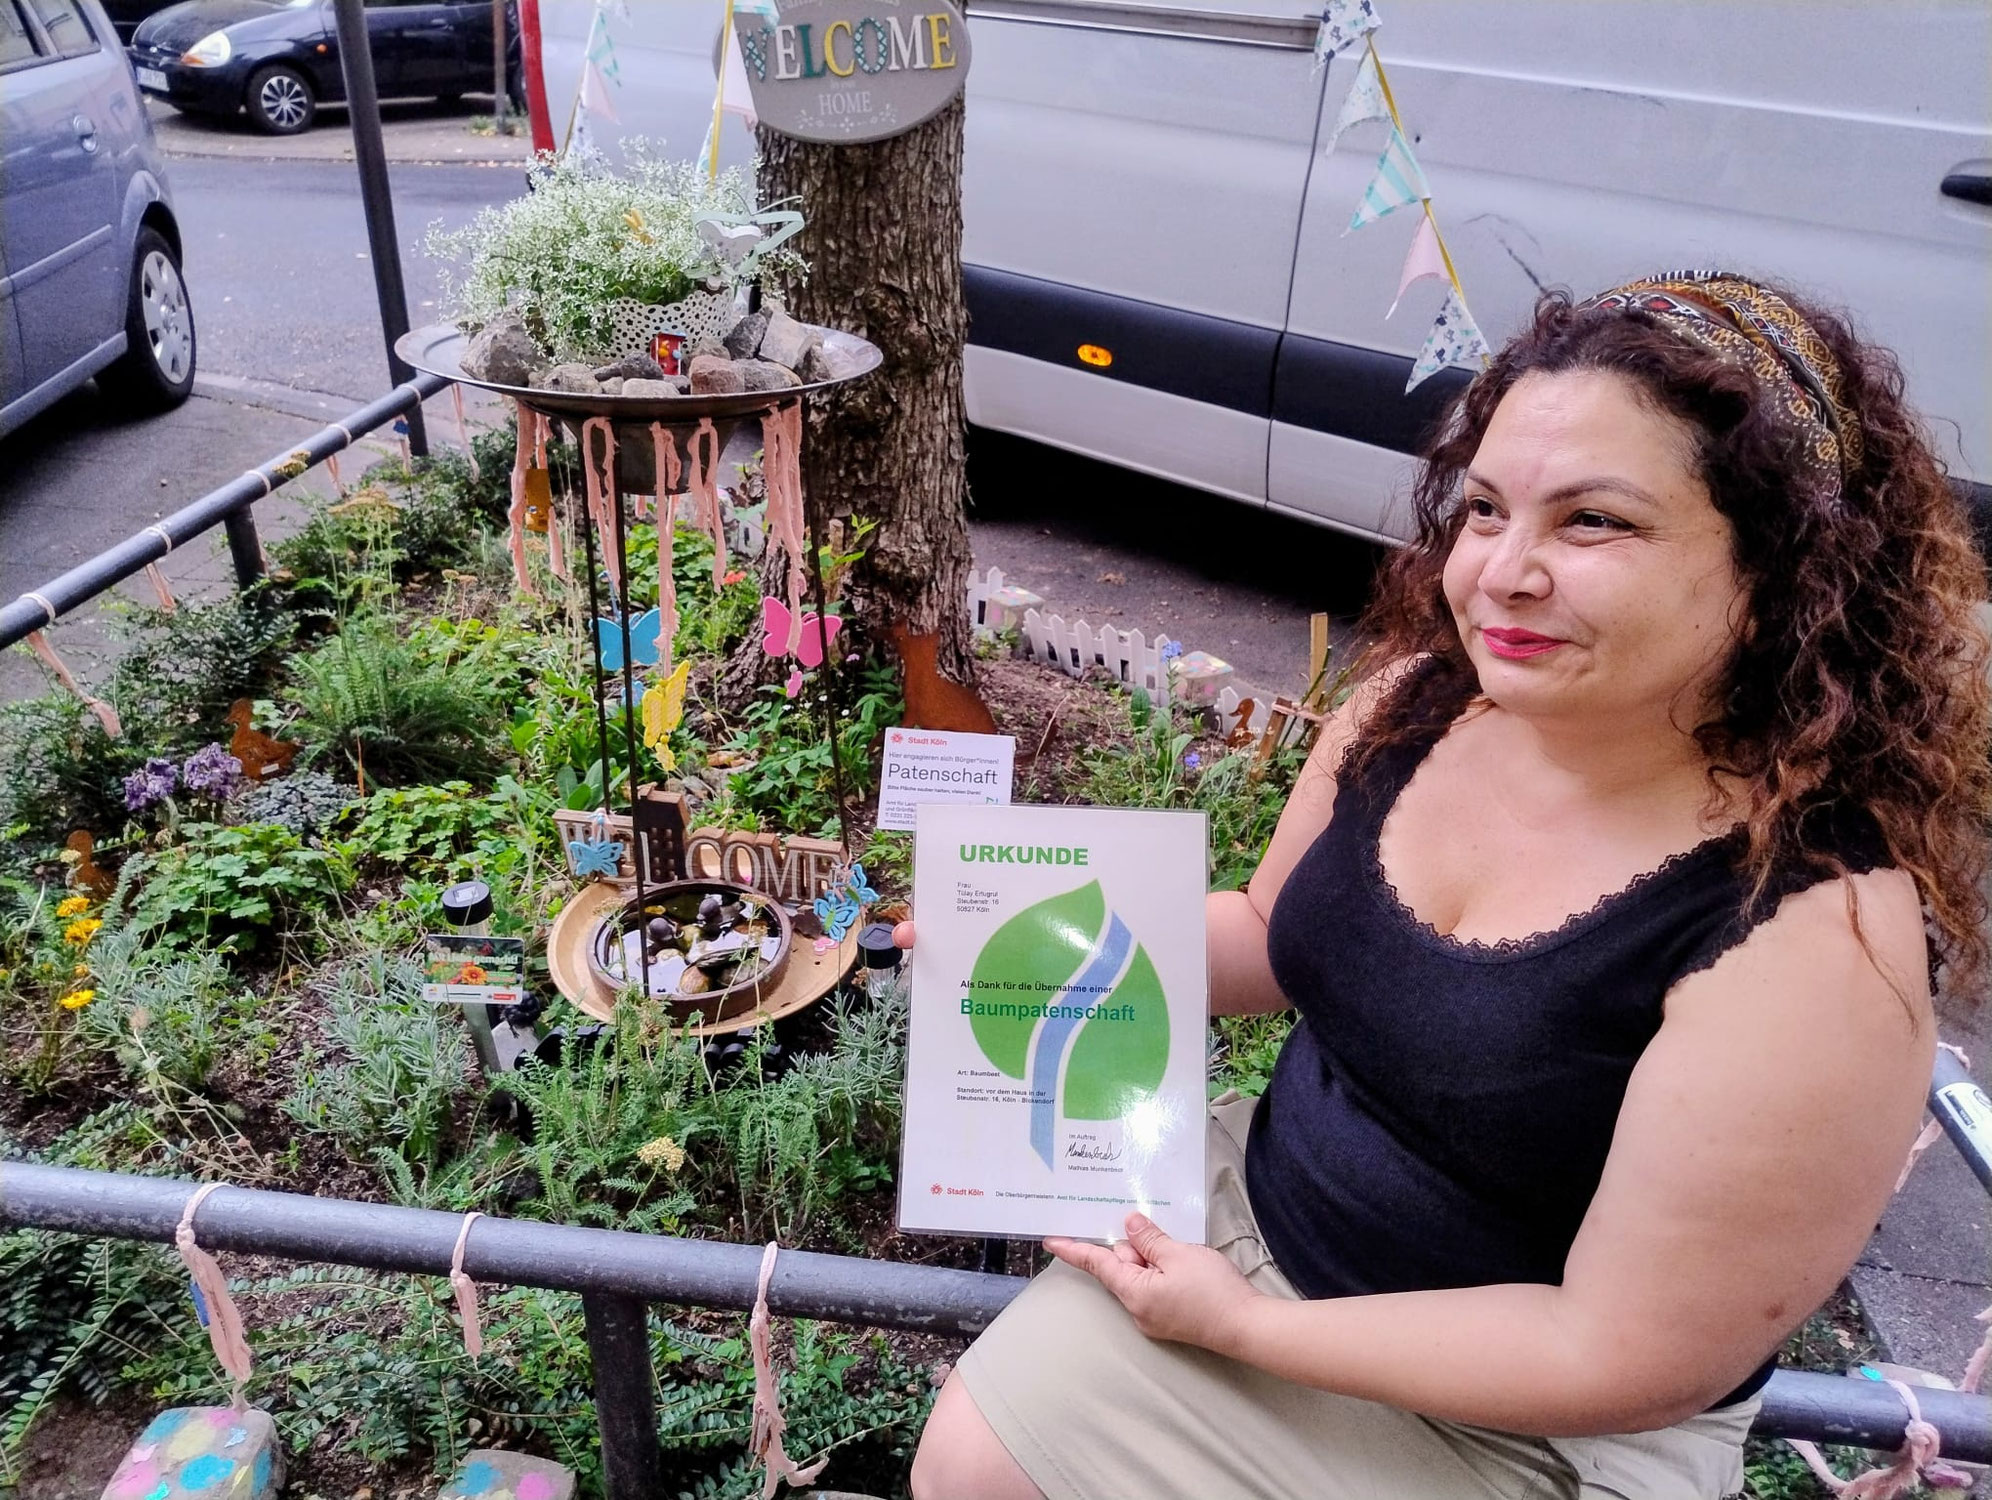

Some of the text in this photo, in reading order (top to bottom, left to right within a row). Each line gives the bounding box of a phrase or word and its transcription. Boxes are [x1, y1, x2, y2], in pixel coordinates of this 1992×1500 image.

[819, 91, 873, 115] HOME
[908, 737, 948, 746] Stadt Köln
[903, 753, 939, 761] engagieren
[888, 763, 998, 785] Patenschaft
[960, 844, 1089, 866] URKUNDE
[960, 980, 1113, 994] Als Dank für die Übernahme einer
[960, 998, 1136, 1022] Baumpatenschaft
[957, 1087, 984, 1095] Standort:
[997, 1088, 1011, 1096] dem
[946, 1187, 984, 1197] Stadt Köln
